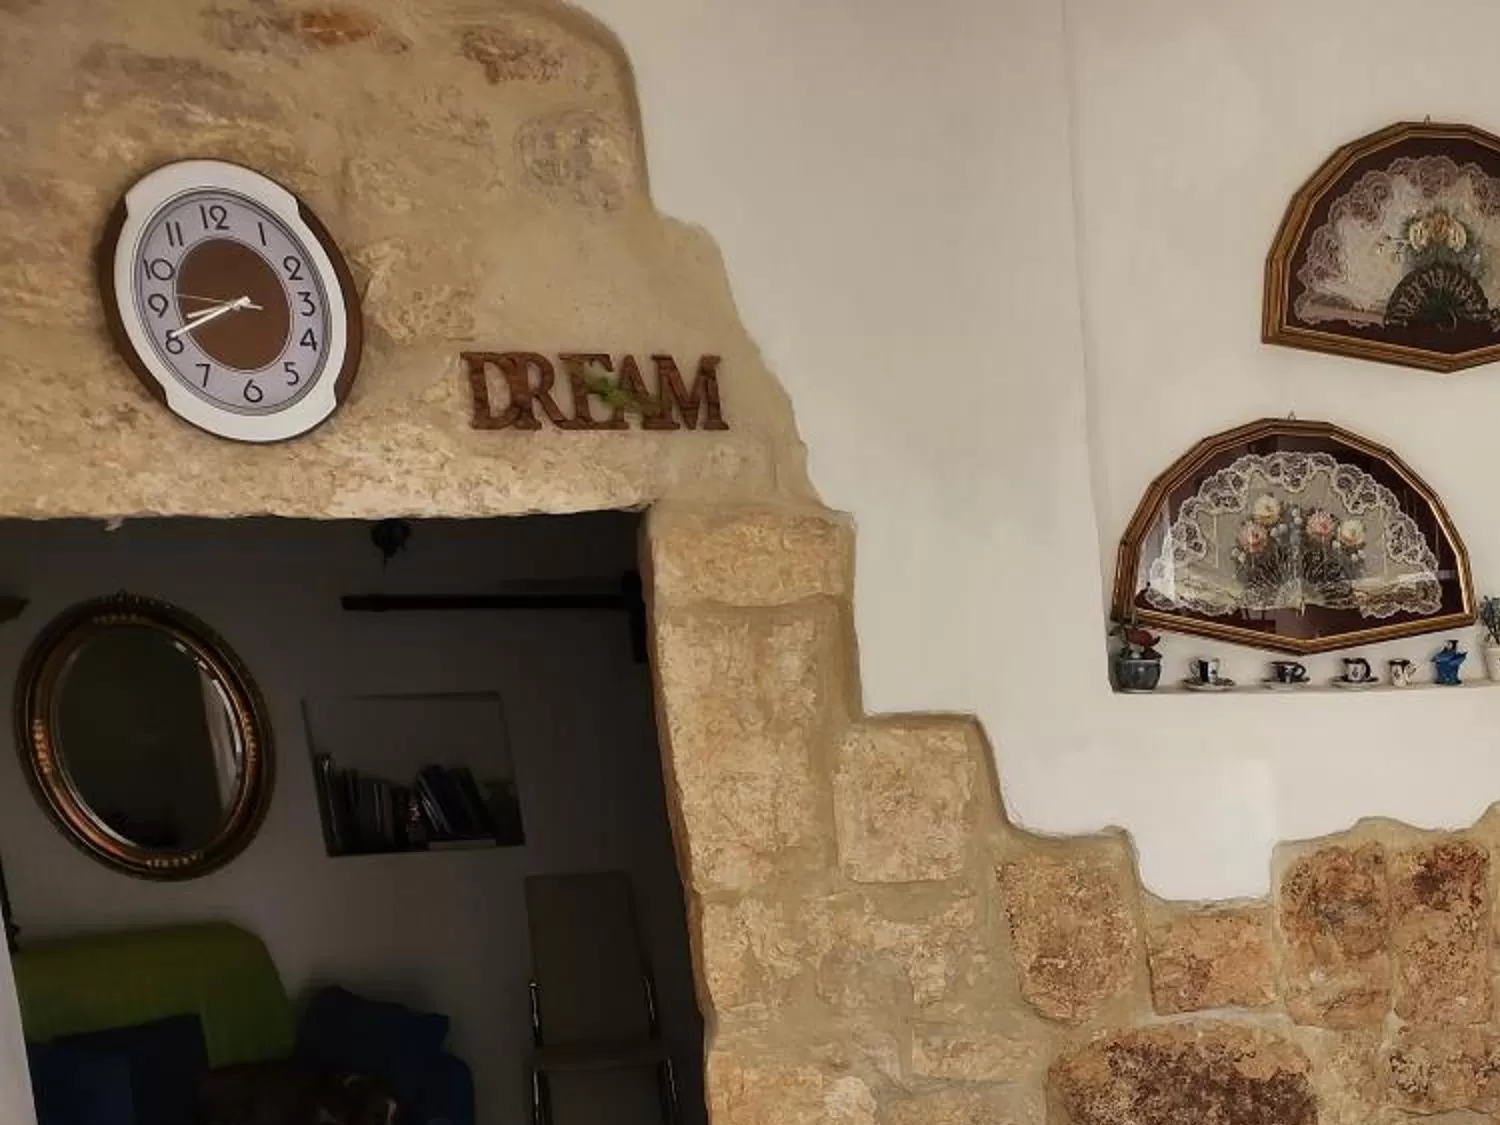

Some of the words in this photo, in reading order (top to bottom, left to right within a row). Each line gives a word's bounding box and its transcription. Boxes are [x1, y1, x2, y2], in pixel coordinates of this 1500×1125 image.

[200, 204, 230, 230] 12
[165, 221, 184, 247] 11
[258, 222, 267, 246] 1
[143, 258, 176, 281] 10
[282, 255, 304, 281] 2
[148, 293, 168, 318] 9
[297, 291, 315, 317] 3
[165, 329, 184, 354] 8
[299, 328, 318, 352] 4
[195, 363, 211, 388] 7
[283, 361, 299, 386] 5
[243, 379, 263, 403] 6
[459, 351, 730, 431] DREAM
